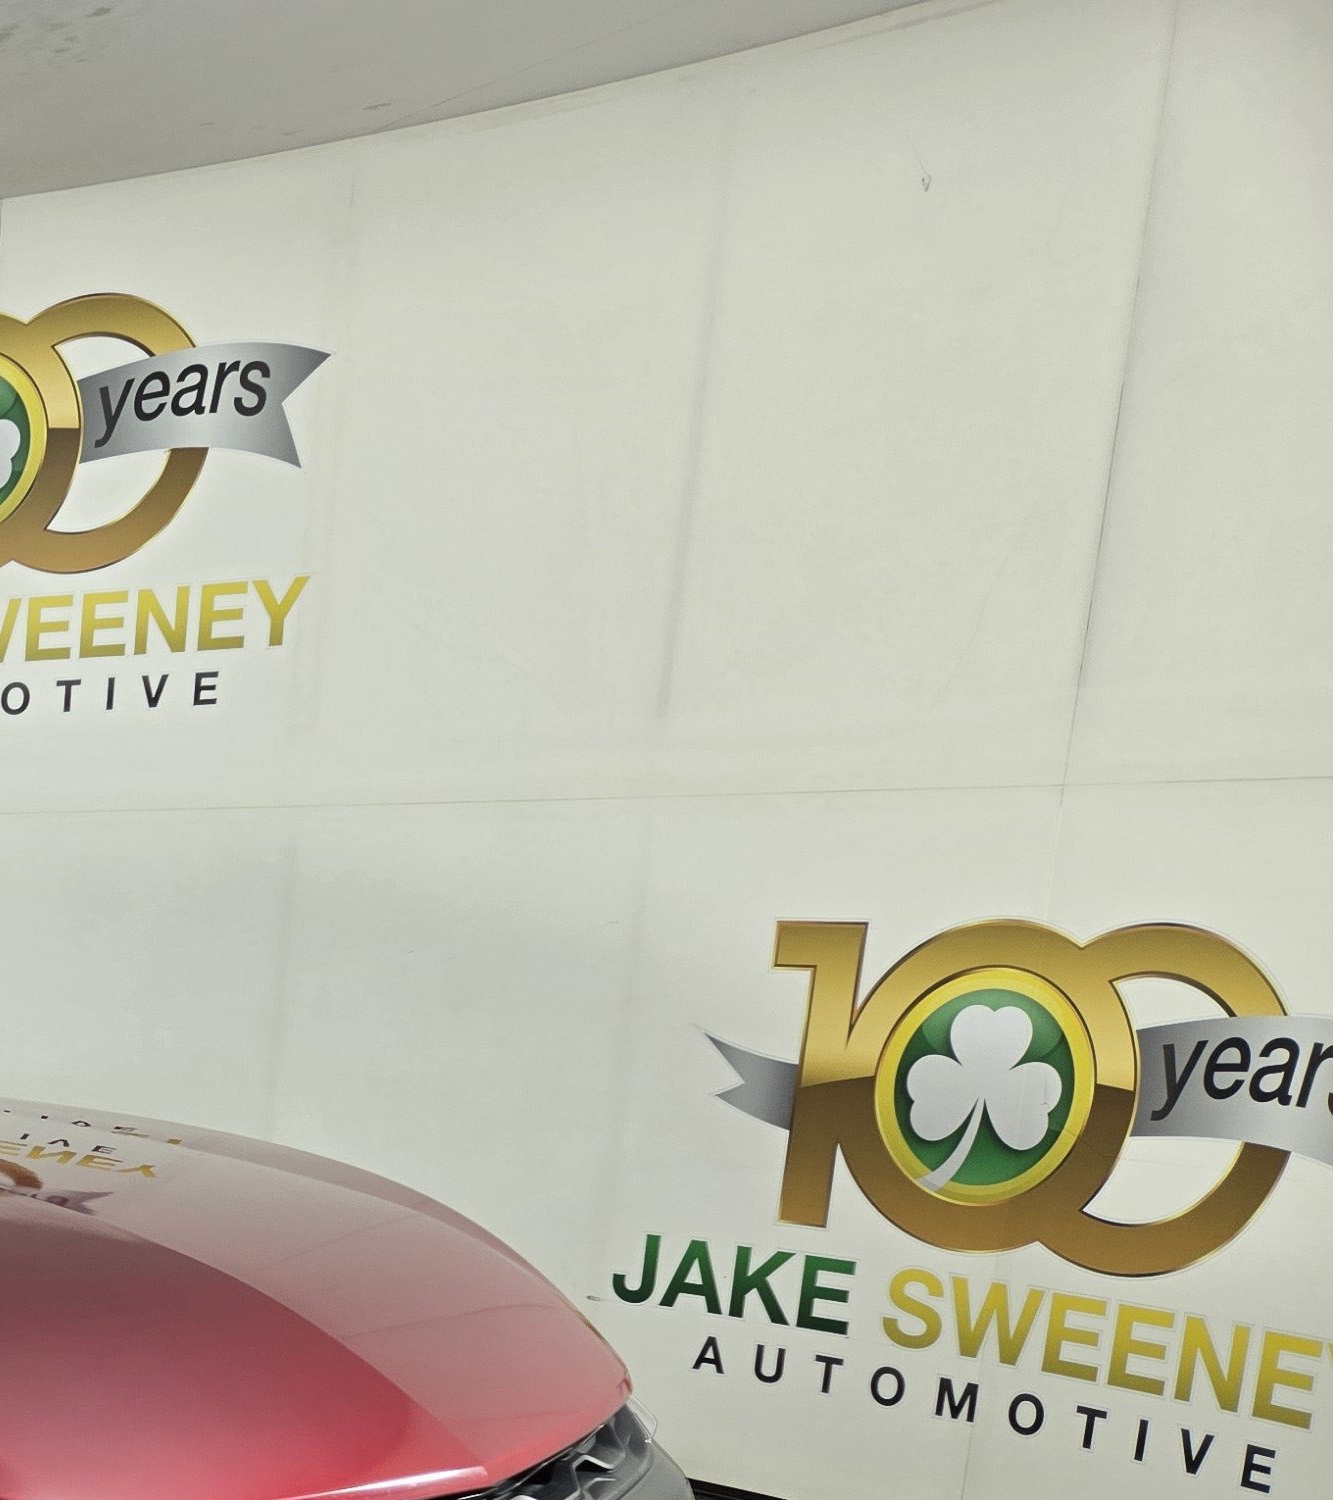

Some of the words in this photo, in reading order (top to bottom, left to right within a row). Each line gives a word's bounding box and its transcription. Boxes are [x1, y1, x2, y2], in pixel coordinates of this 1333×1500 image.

[94, 357, 271, 447] years
[772, 919, 1291, 1277] 100
[612, 1234, 857, 1335] JAKE
[882, 1269, 1333, 1430] SWEENE
[693, 1336, 1276, 1494] AUTOMOTIVE
